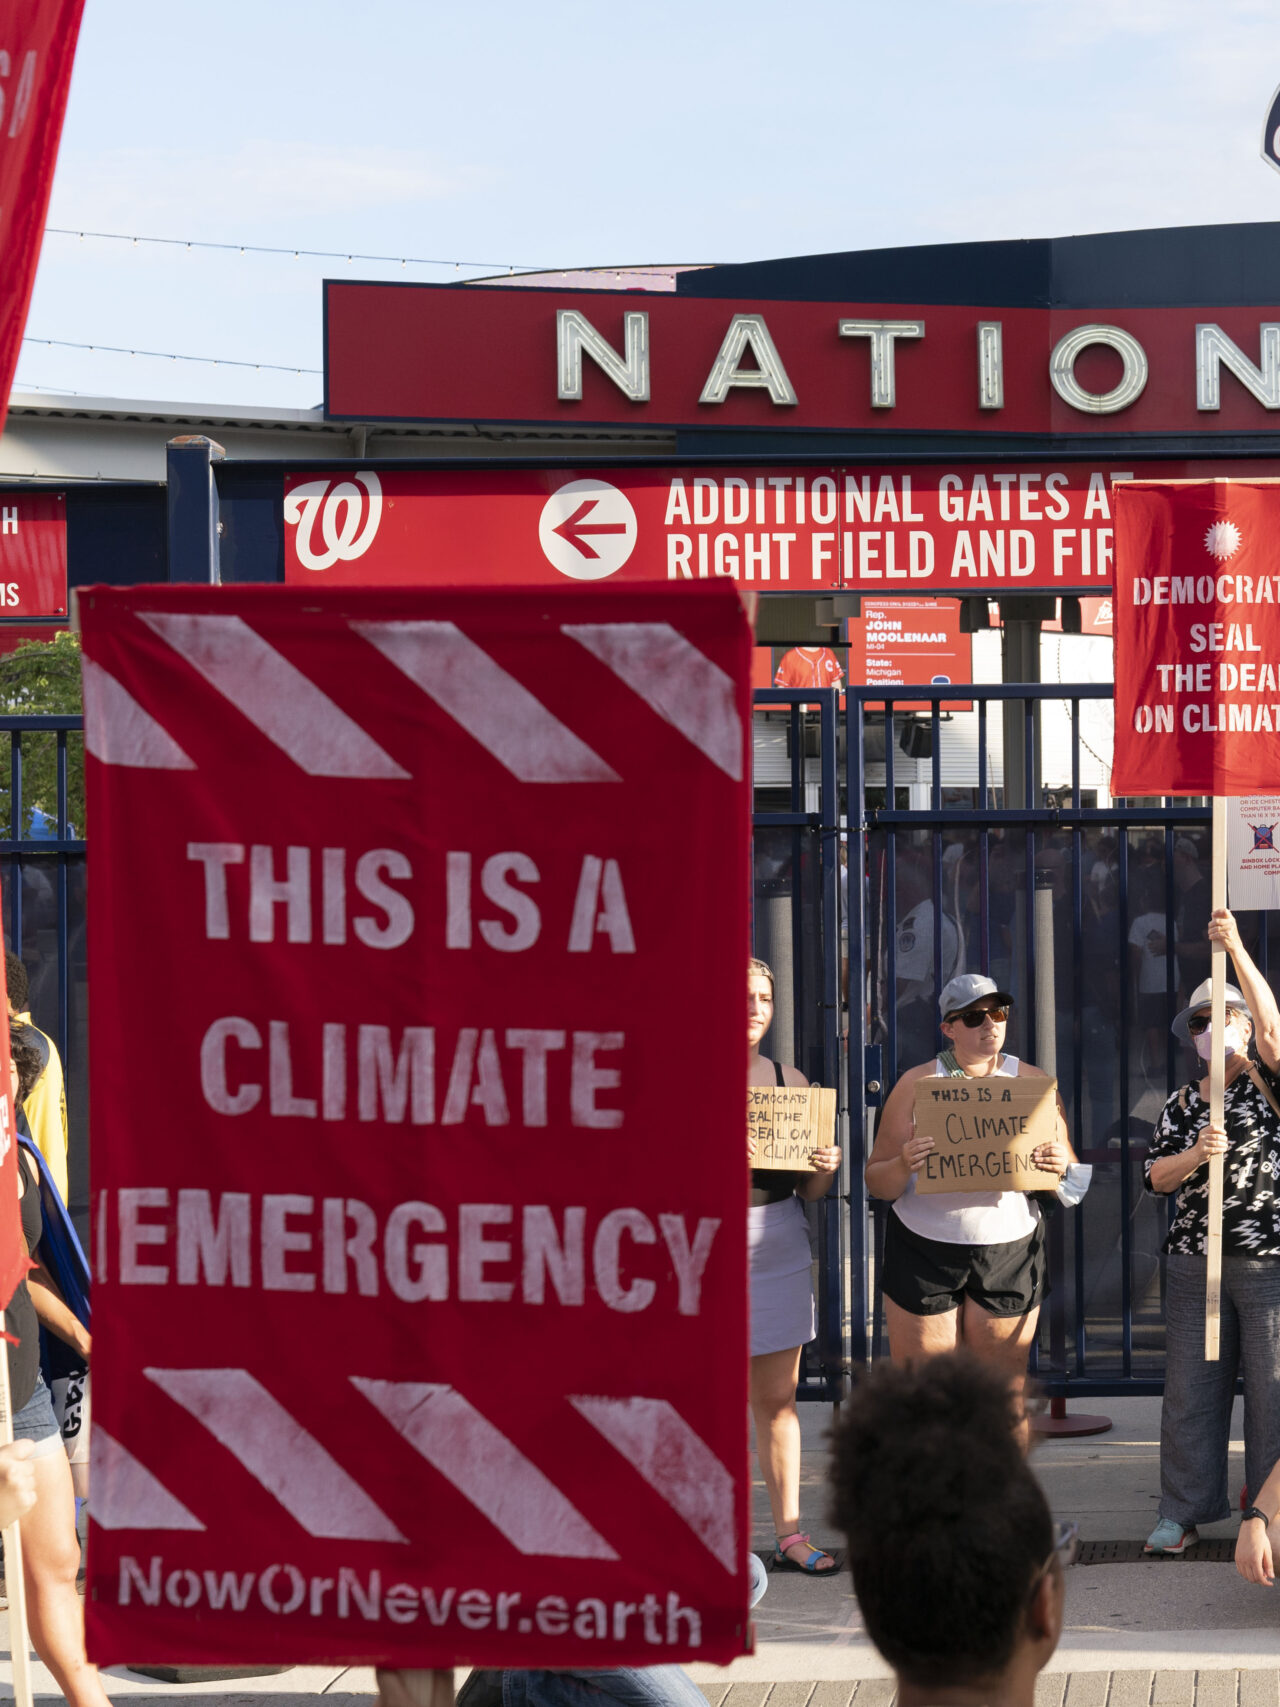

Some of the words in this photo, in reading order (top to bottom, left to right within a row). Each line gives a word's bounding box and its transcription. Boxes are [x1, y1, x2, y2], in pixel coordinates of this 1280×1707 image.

[664, 475, 924, 526] ADDITIONAL
[938, 472, 1070, 523] GATES
[283, 470, 383, 571] W
[666, 533, 796, 581] RIGHT
[812, 531, 935, 580] FIELD
[950, 529, 1035, 577] AND
[865, 610, 887, 619] Rep.
[865, 621, 902, 630] JOHN
[866, 632, 947, 643] MOOLENAAR
[1189, 623, 1262, 653] SEAL
[866, 659, 892, 667] State:
[1156, 663, 1211, 693] THE
[1134, 704, 1174, 734] ON
[187, 842, 415, 950] THIS
[445, 850, 541, 953] IS
[567, 855, 636, 954] A
[200, 1015, 626, 1129] CLIMATE
[931, 1088, 970, 1102] THIS
[977, 1088, 992, 1102] IS
[1002, 1089, 1012, 1102] A
[748, 1111, 771, 1122] EAL
[774, 1112, 803, 1122] THE
[945, 1113, 1029, 1144] CLIMATE
[790, 1128, 811, 1140] ON
[764, 1144, 822, 1160] CLIMAT
[926, 1151, 1042, 1180] EMERGENC
[118, 1187, 722, 1316] EMERGENCY
[117, 1555, 702, 1648] NowOrNever.earth
